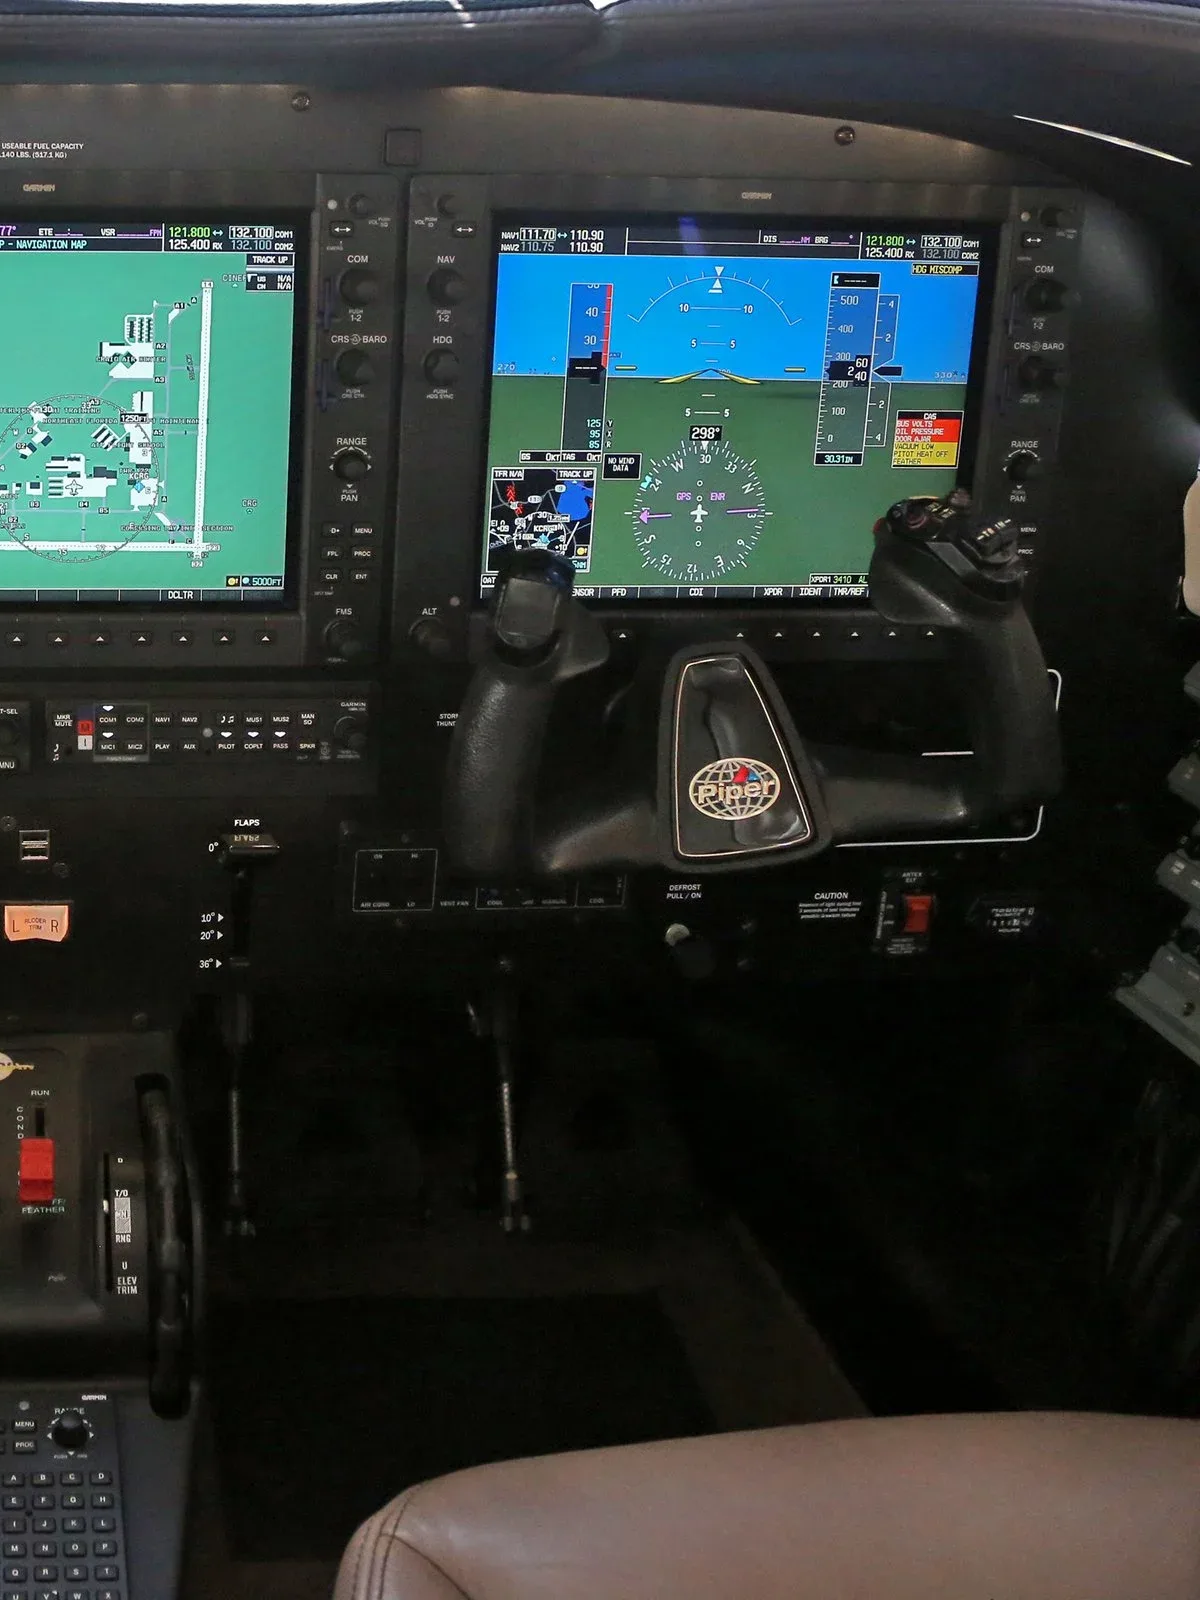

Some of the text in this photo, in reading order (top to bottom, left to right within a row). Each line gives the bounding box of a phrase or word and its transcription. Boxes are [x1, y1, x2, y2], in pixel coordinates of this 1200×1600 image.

[2, 142, 31, 150] USEABLE
[34, 142, 49, 150] FUEL
[17, 240, 68, 249] NAVIGATION
[71, 240, 87, 249] MAP
[253, 255, 288, 264] TRACK UP
[692, 428, 720, 439] 298°
[833, 576, 851, 584] 3410
[168, 591, 193, 599] DCLTR
[612, 588, 626, 596] PFD
[690, 588, 703, 596] CDI
[764, 588, 782, 596] XPDR
[800, 588, 822, 596] IDENT
[834, 587, 865, 596] TMR/REF
[100, 716, 117, 724] COM1
[246, 716, 262, 724] MUS1
[273, 742, 288, 750] PASS
[698, 778, 775, 803] Piper
[815, 892, 848, 900] CAUTION
[116, 1235, 131, 1243] RNG
[118, 1276, 137, 1286] ELEV
[117, 1286, 137, 1294] TRIM
